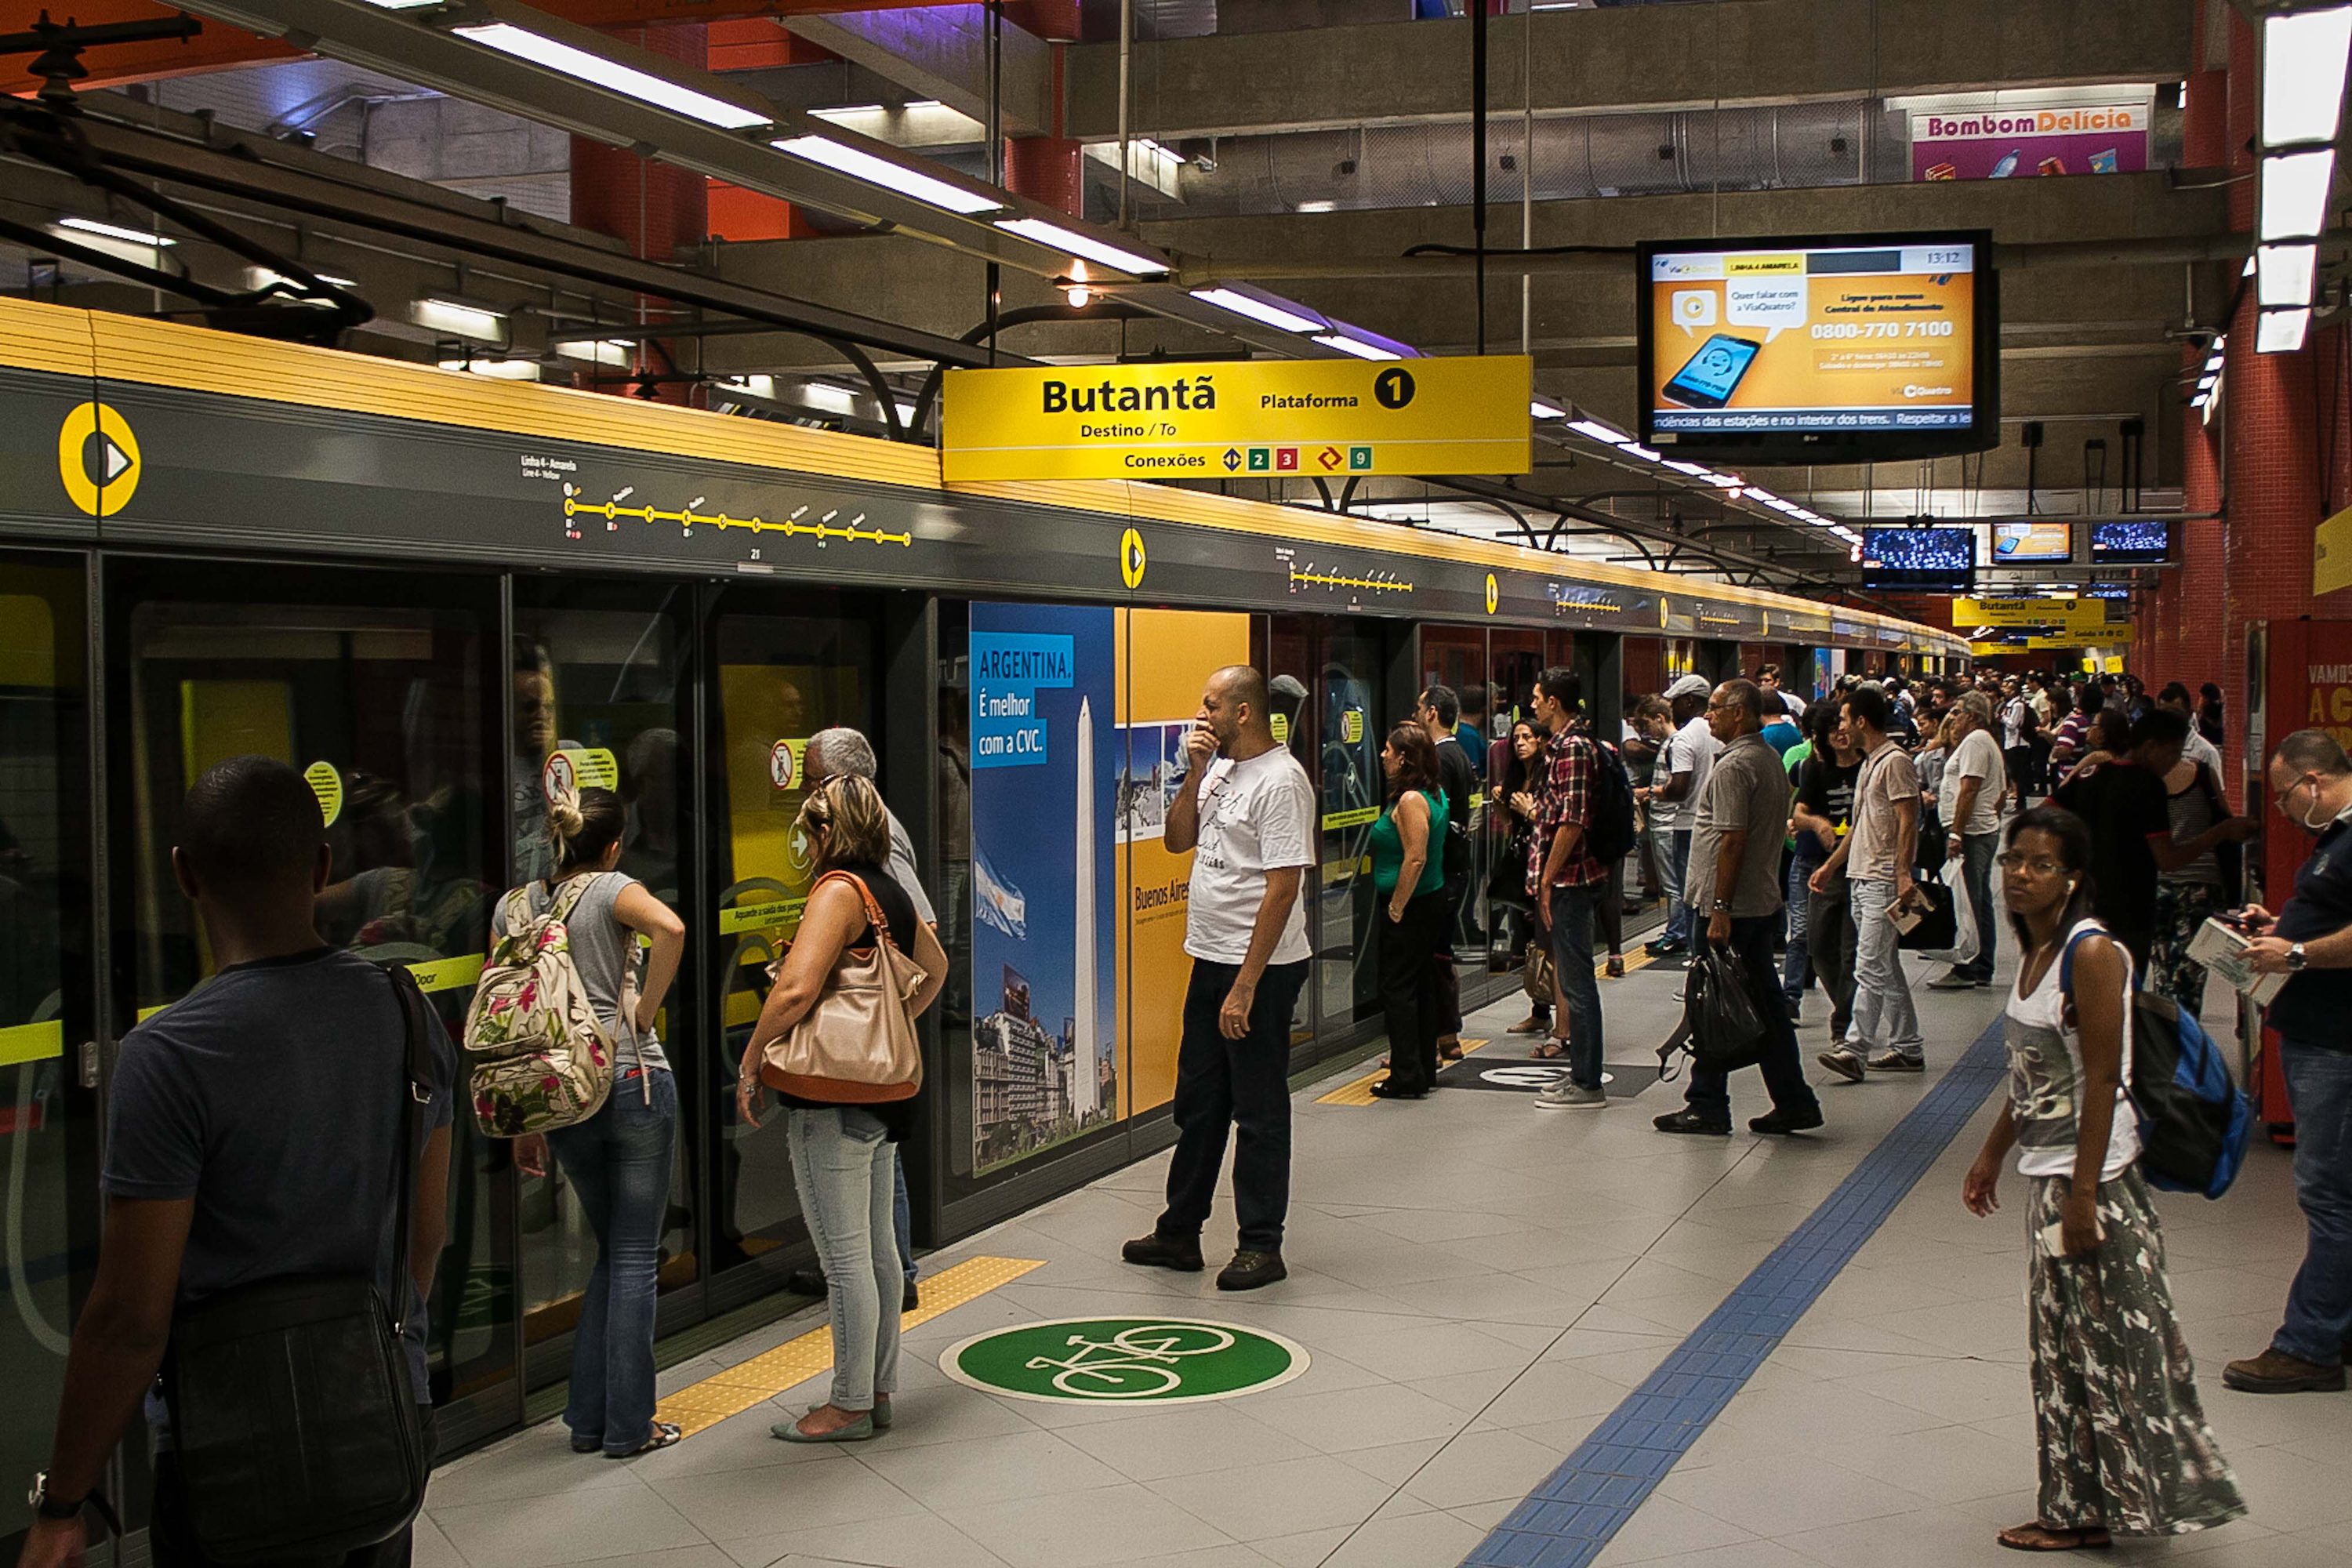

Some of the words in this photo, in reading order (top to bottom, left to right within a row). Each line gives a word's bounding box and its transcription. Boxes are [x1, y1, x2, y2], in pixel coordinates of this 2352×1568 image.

[1761, 262, 1799, 270] AMARELA
[1926, 251, 1960, 265] 13:12
[1731, 291, 1755, 301] Quer
[1756, 290, 1777, 299] falar
[1841, 294, 1867, 303] Ligue
[1870, 294, 1893, 303] para
[1824, 304, 1860, 314] Central
[1878, 303, 1944, 312] Atendimento
[1810, 321, 1900, 339] 0800-770
[1904, 320, 1953, 338] 7100
[1042, 375, 1217, 414] Butantã
[1261, 392, 1359, 410] Plataforma
[1653, 416, 1700, 428] ndências
[1702, 416, 1722, 427] das
[1723, 415, 1769, 429] estações
[1770, 418, 1780, 426] e
[1780, 416, 1795, 426] no
[1796, 414, 1835, 426] interior
[1837, 413, 1858, 426] dos
[1859, 413, 1891, 426] trens.
[1896, 412, 1947, 427] Respeitar
[1948, 415, 1958, 424] a
[1080, 423, 1145, 438] Destino
[1159, 422, 1178, 437] To
[521, 454, 540, 468] Linha
[1124, 452, 1207, 469] Conexões
[1979, 600, 2026, 611] Butantã
[978, 649, 1072, 680] ARGENTINA.
[979, 687, 987, 718] É
[989, 692, 1031, 717] melhor
[979, 735, 1004, 756] com
[1007, 736, 1014, 754] a
[1015, 728, 1044, 753] CVC.
[1135, 886, 1168, 912] Buenos
